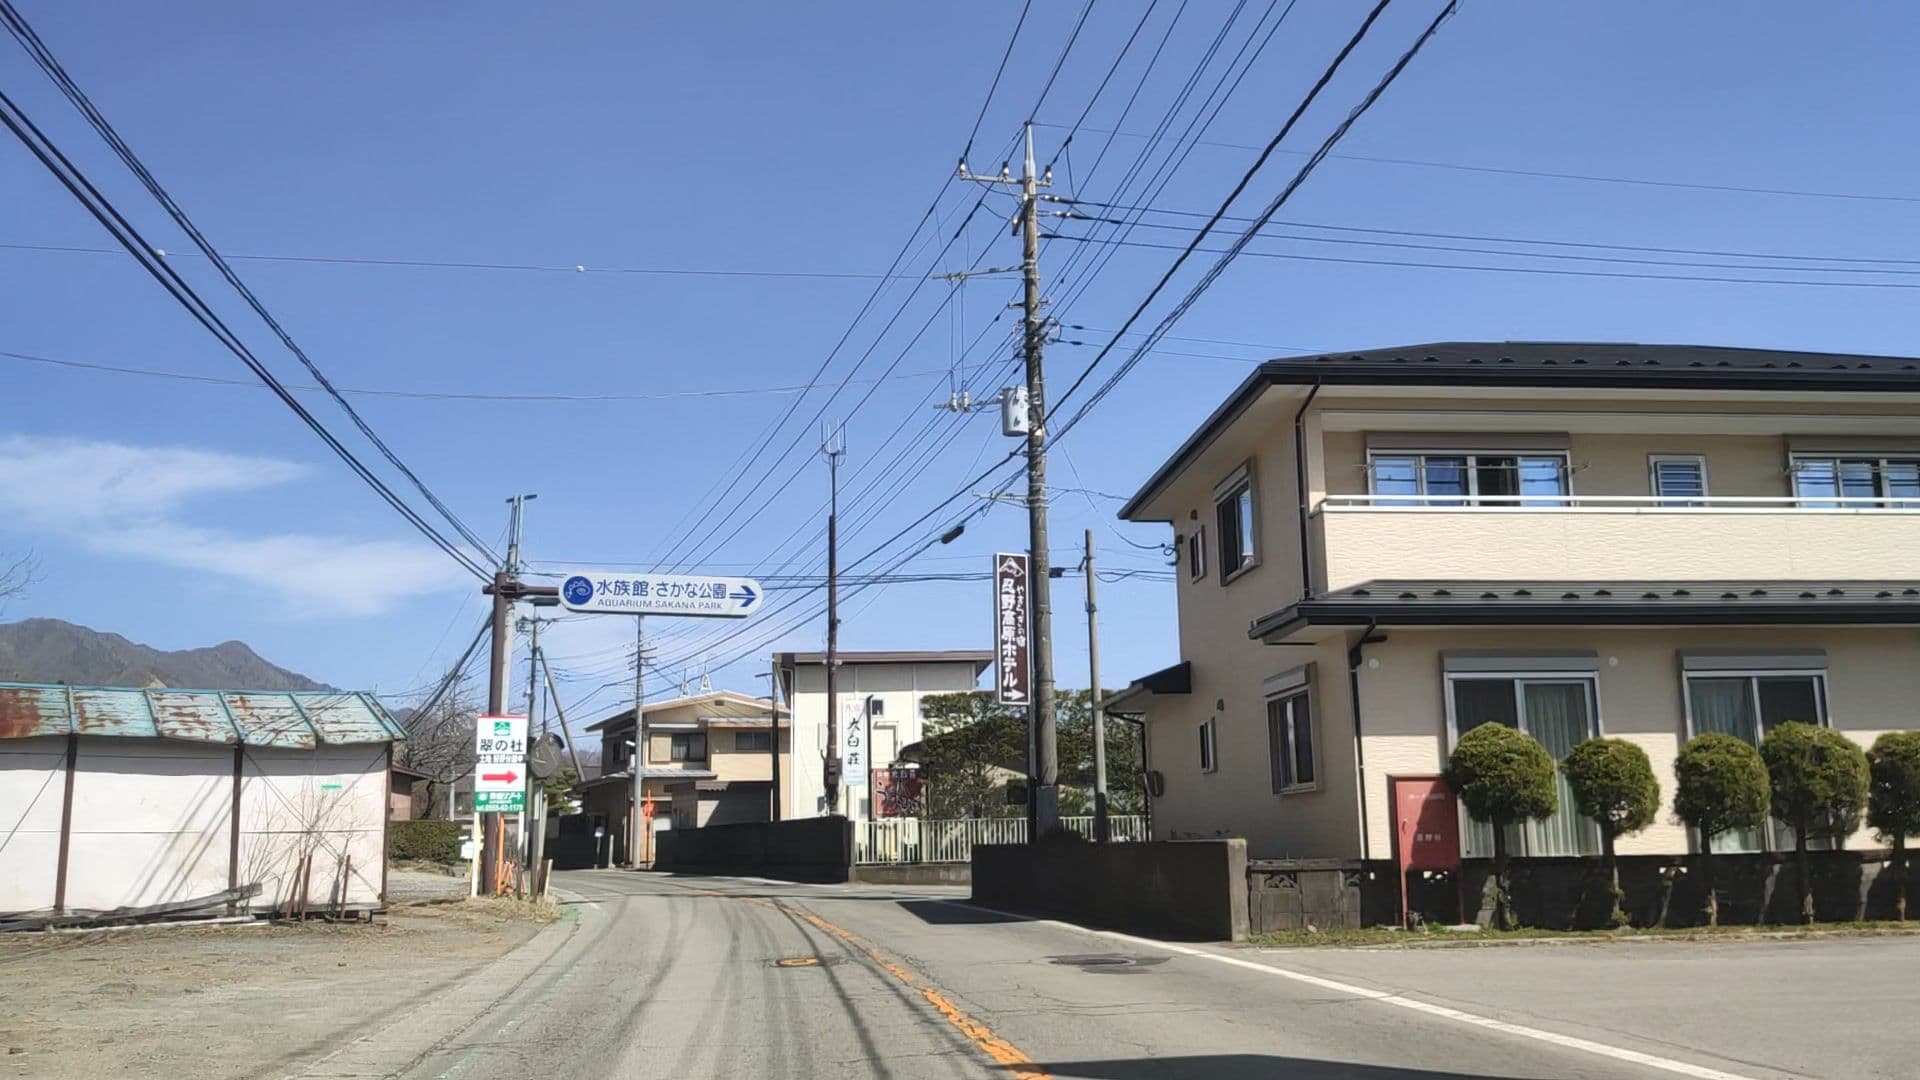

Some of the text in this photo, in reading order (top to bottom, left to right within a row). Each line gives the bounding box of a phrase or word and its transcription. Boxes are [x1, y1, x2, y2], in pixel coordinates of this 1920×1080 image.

[597, 599, 723, 610] AQUARIUM SAKANA PARK
[480, 738, 524, 753] 翠の杜
